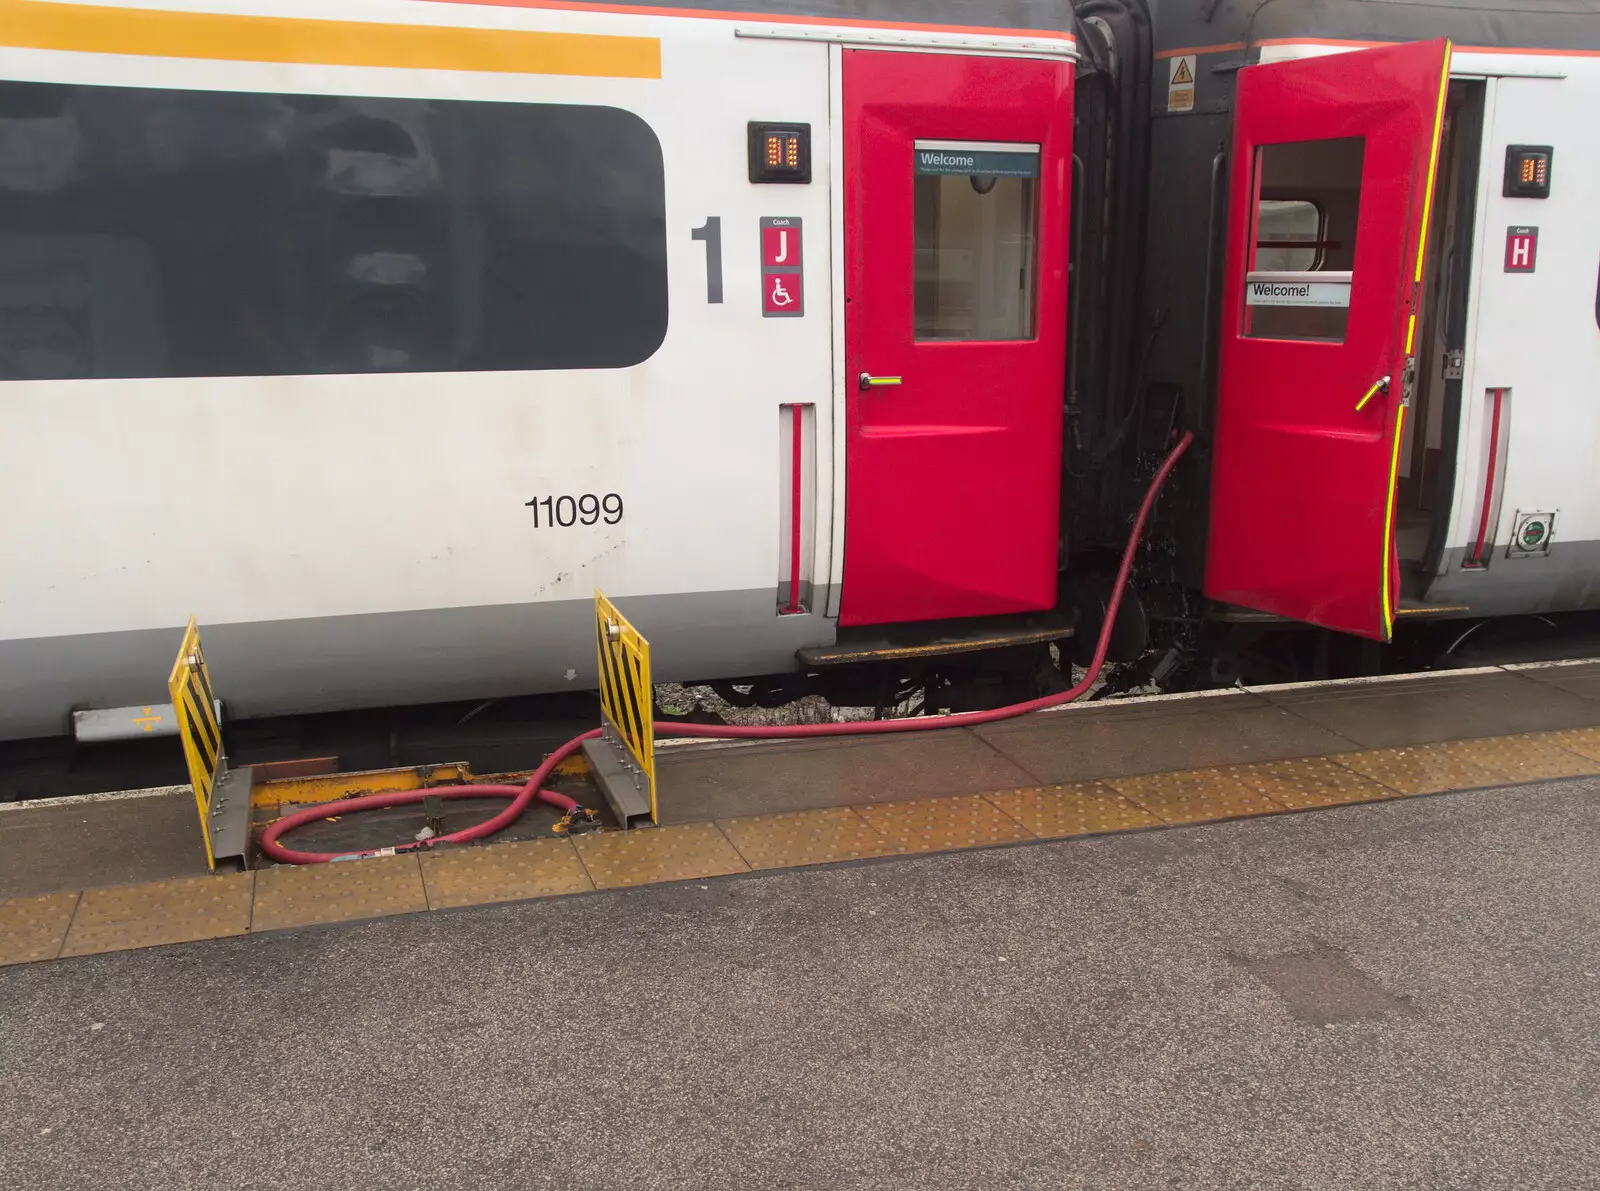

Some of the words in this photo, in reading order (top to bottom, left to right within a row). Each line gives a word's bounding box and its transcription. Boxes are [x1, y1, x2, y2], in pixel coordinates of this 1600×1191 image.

[921, 153, 974, 166] Welcome
[691, 216, 724, 304] 1
[775, 231, 787, 263] J
[1512, 238, 1530, 266] H
[1253, 284, 1310, 297] Welcome!
[525, 493, 624, 528] 11099
